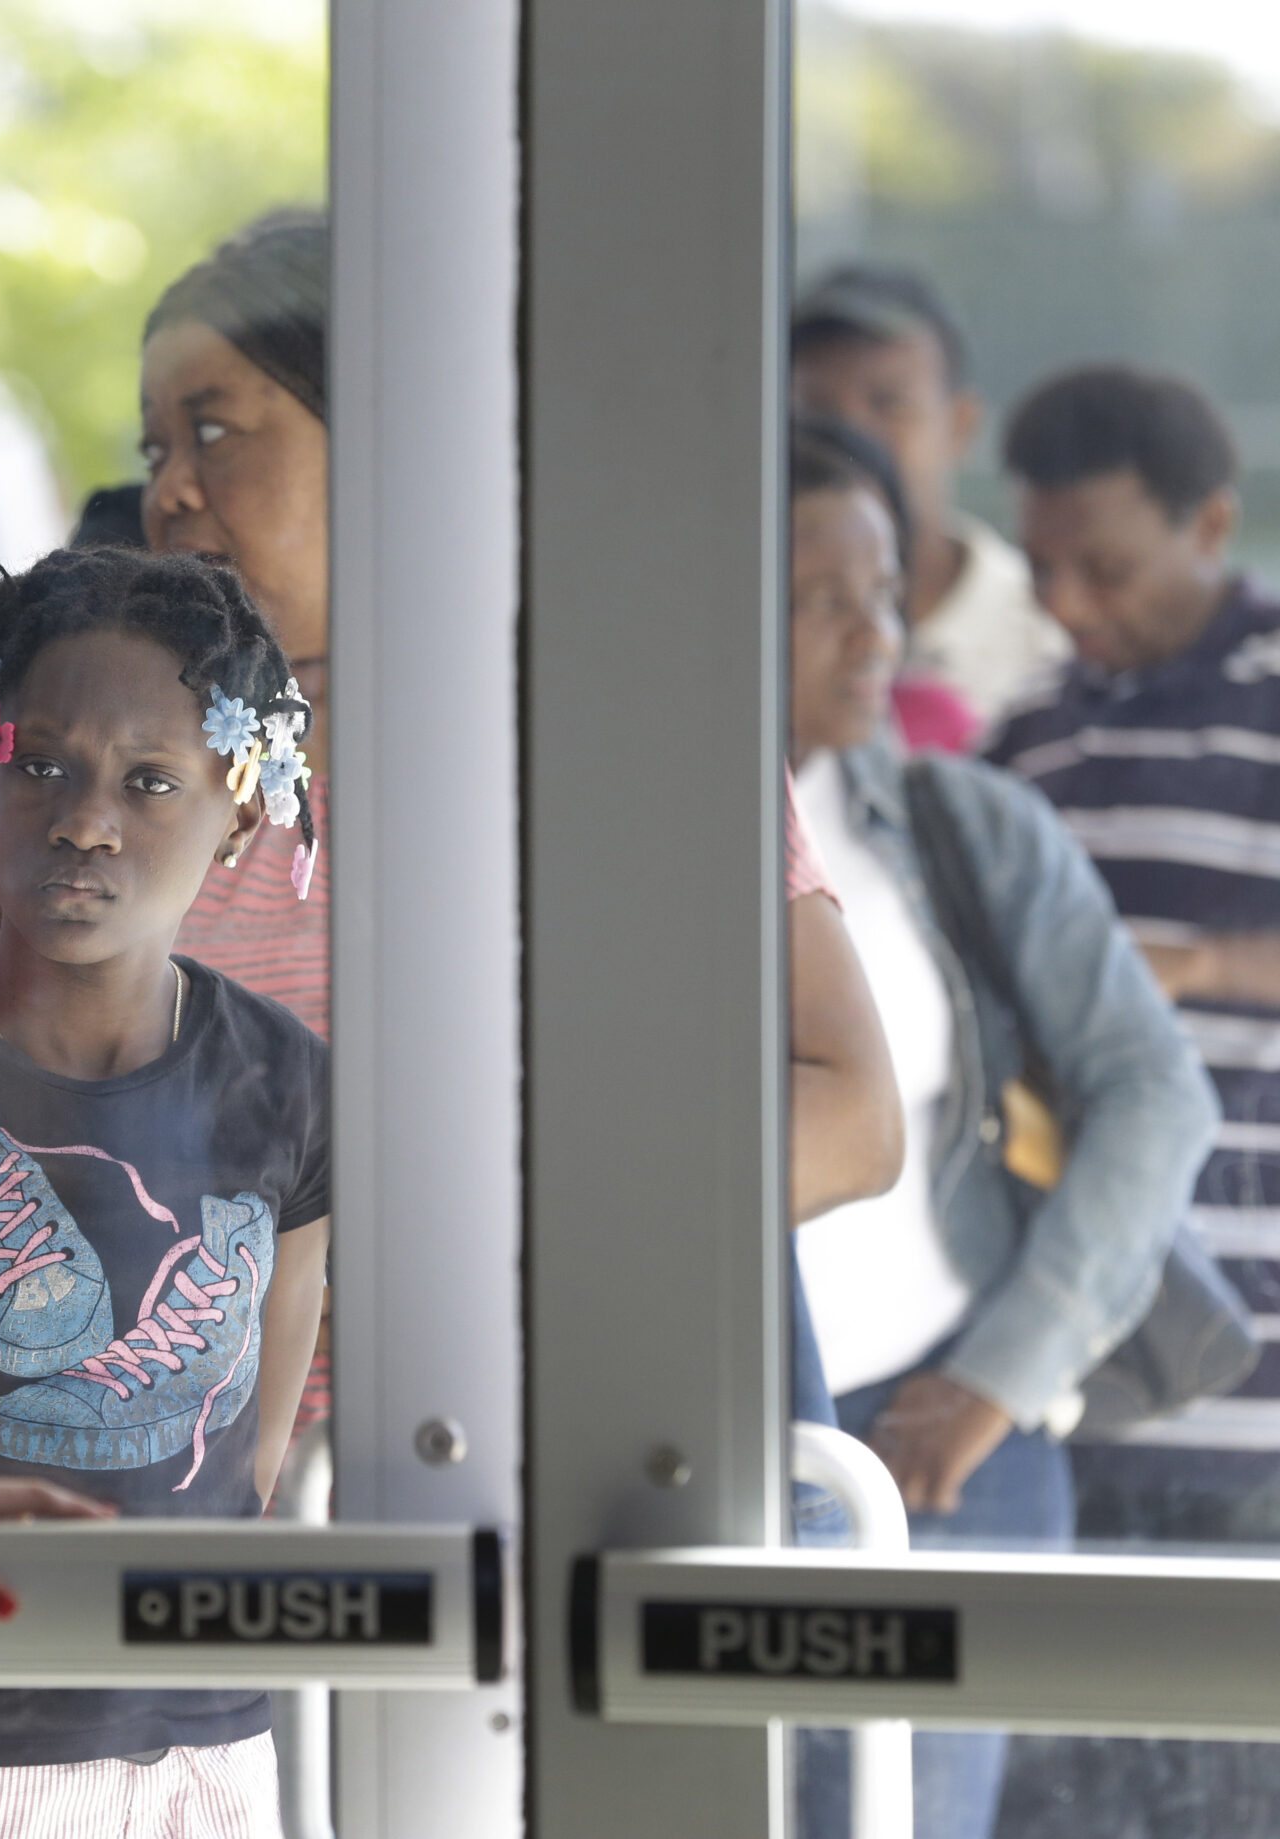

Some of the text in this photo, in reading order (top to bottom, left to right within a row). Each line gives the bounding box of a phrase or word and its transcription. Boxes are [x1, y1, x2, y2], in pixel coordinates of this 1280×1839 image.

[13, 1264, 77, 1311] BE
[178, 1579, 380, 1639] PUSH
[697, 1608, 906, 1676] PUSH
